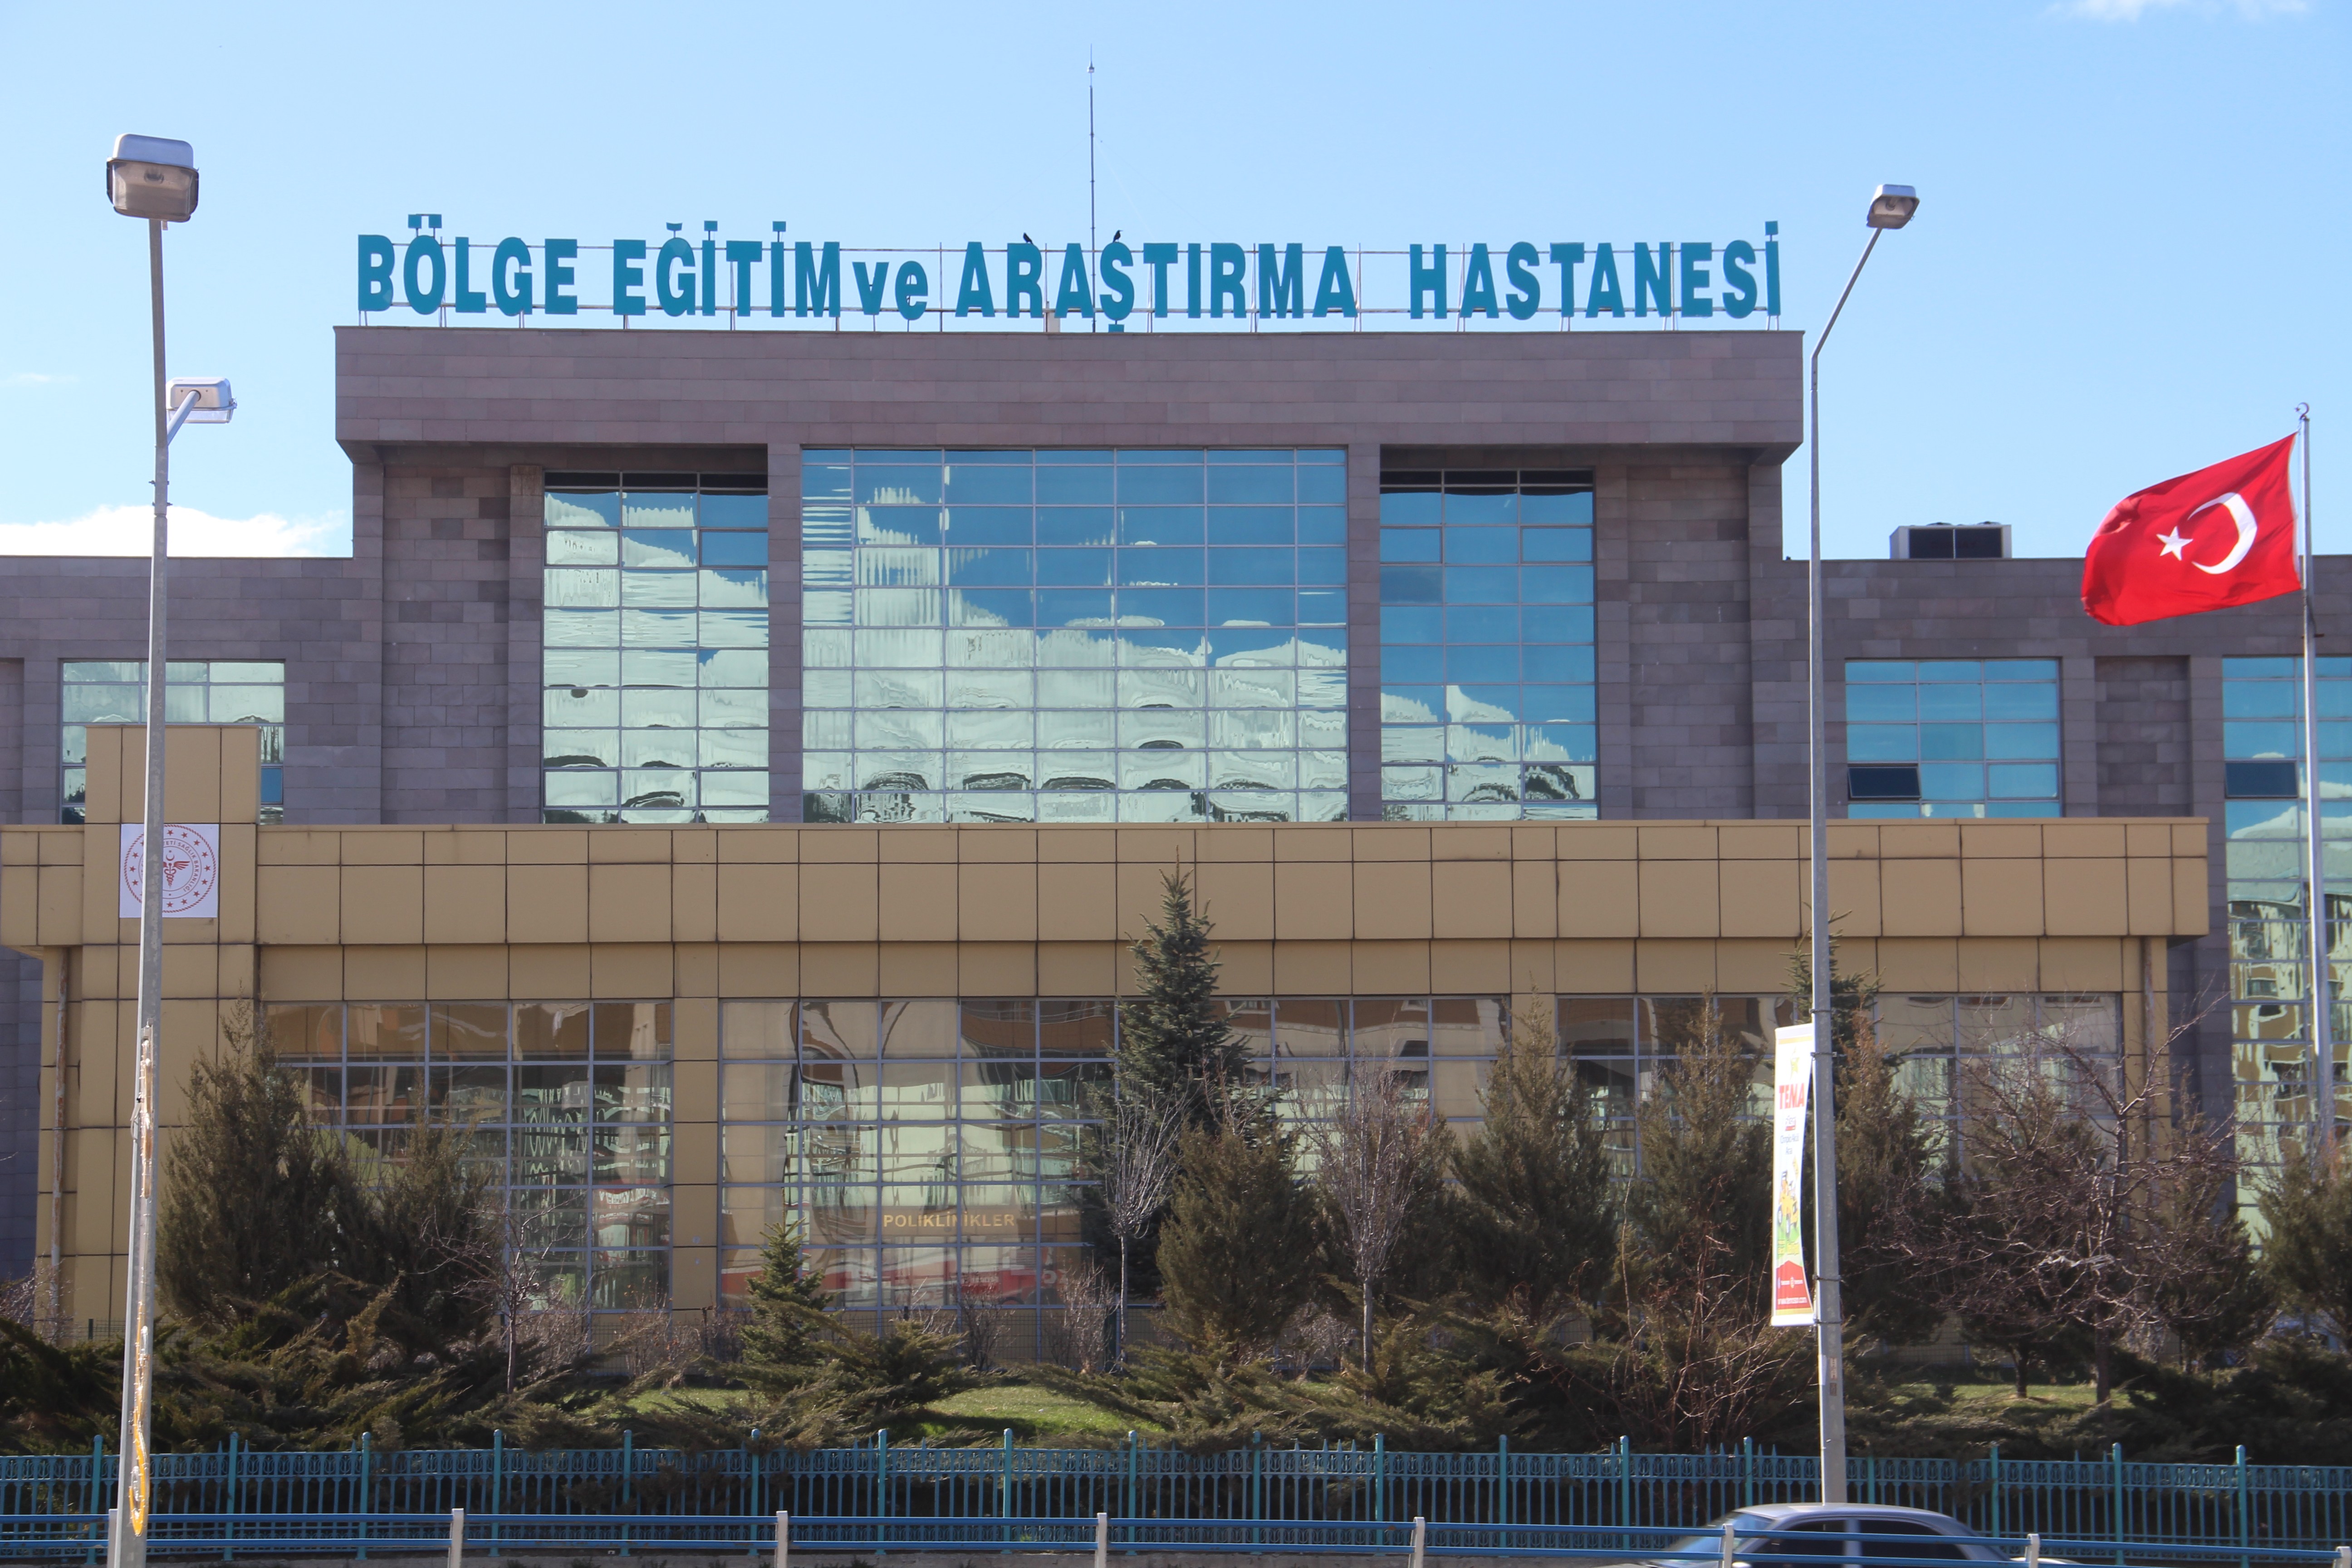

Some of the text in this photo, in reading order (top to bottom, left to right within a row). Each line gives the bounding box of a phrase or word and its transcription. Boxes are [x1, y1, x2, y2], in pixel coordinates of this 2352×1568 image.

[358, 214, 1781, 333] BÖLGE EĞİTİM ve ARAŞTIRMA HASTANESİ
[177, 842, 197, 859] SAĞLIK
